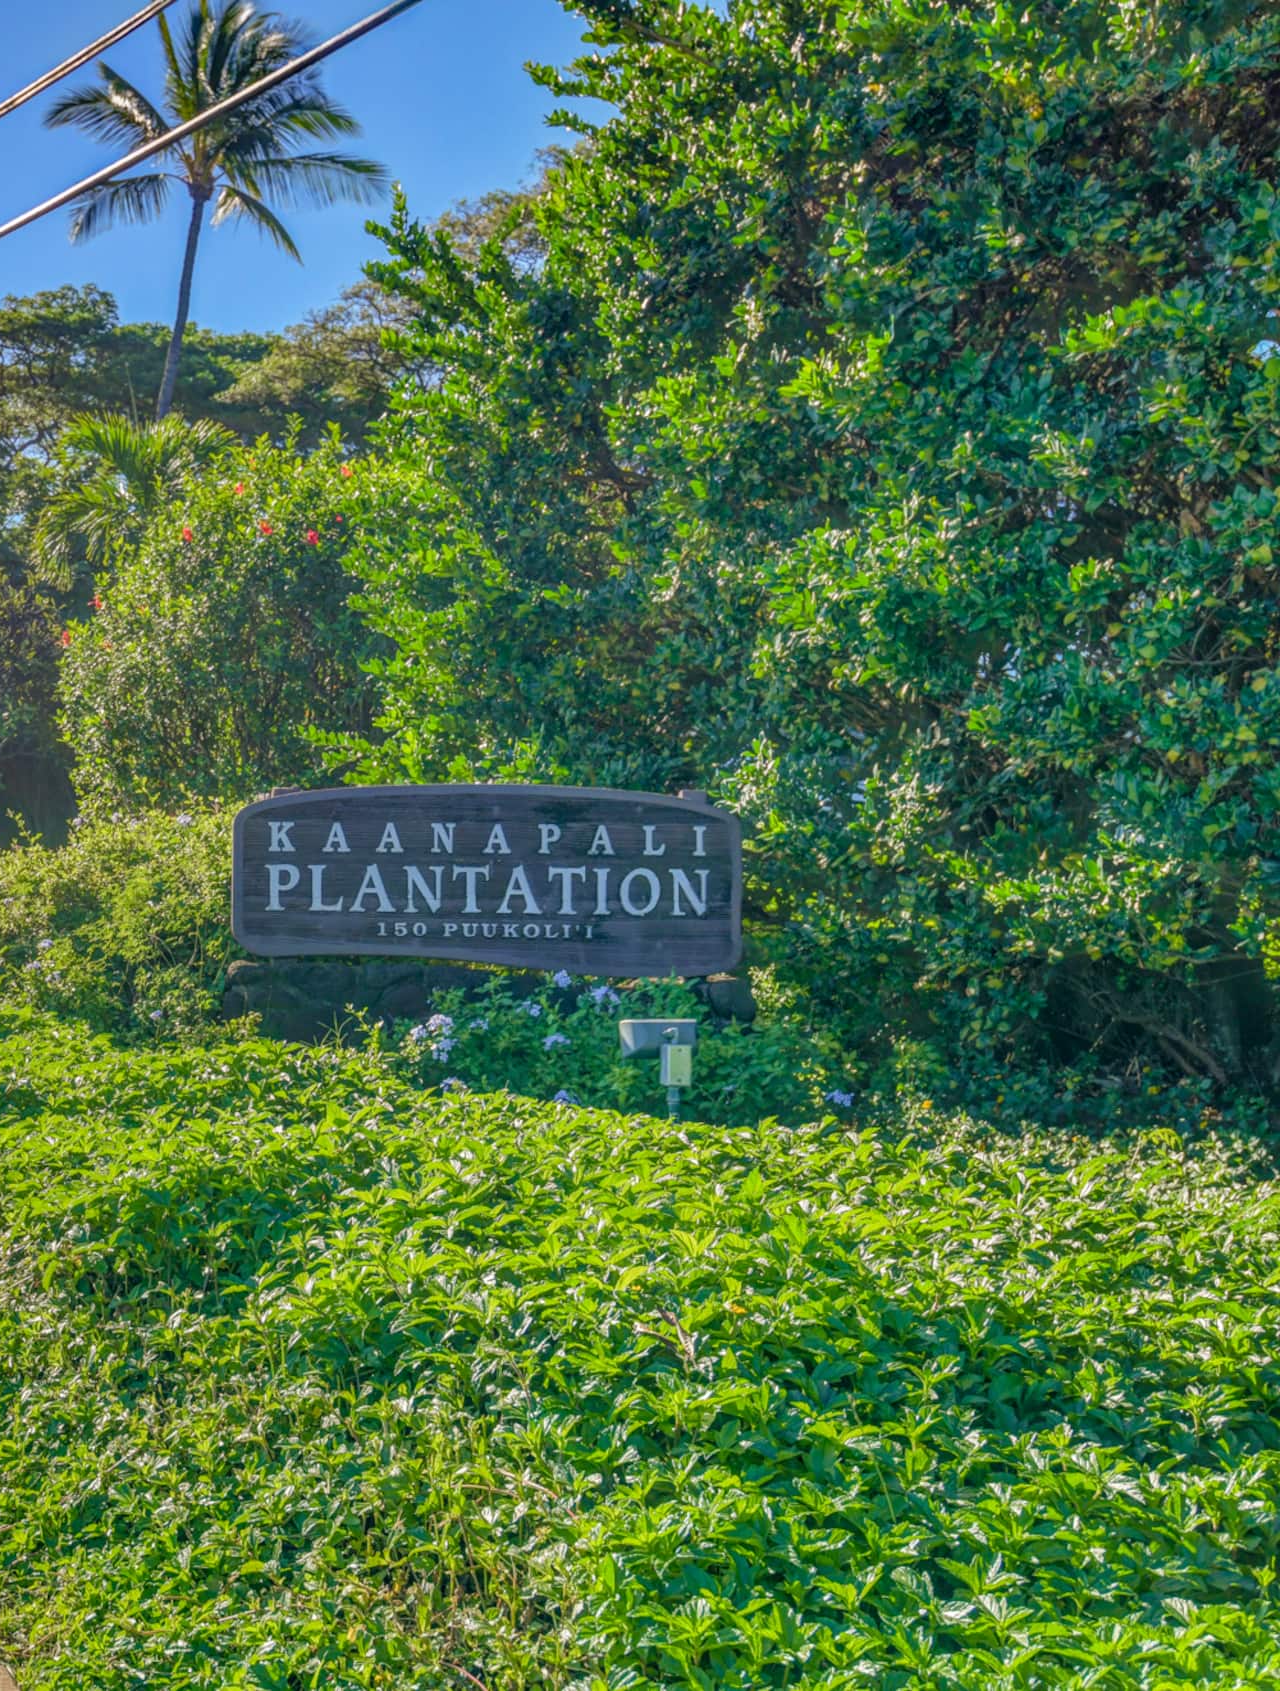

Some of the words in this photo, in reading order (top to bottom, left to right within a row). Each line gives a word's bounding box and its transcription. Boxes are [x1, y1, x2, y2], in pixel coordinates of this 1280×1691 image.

[268, 821, 708, 857] KAANAPALI
[264, 863, 710, 917] PLANTATION
[377, 921, 427, 937] 150
[443, 922, 594, 939] PUUKOLI'I
